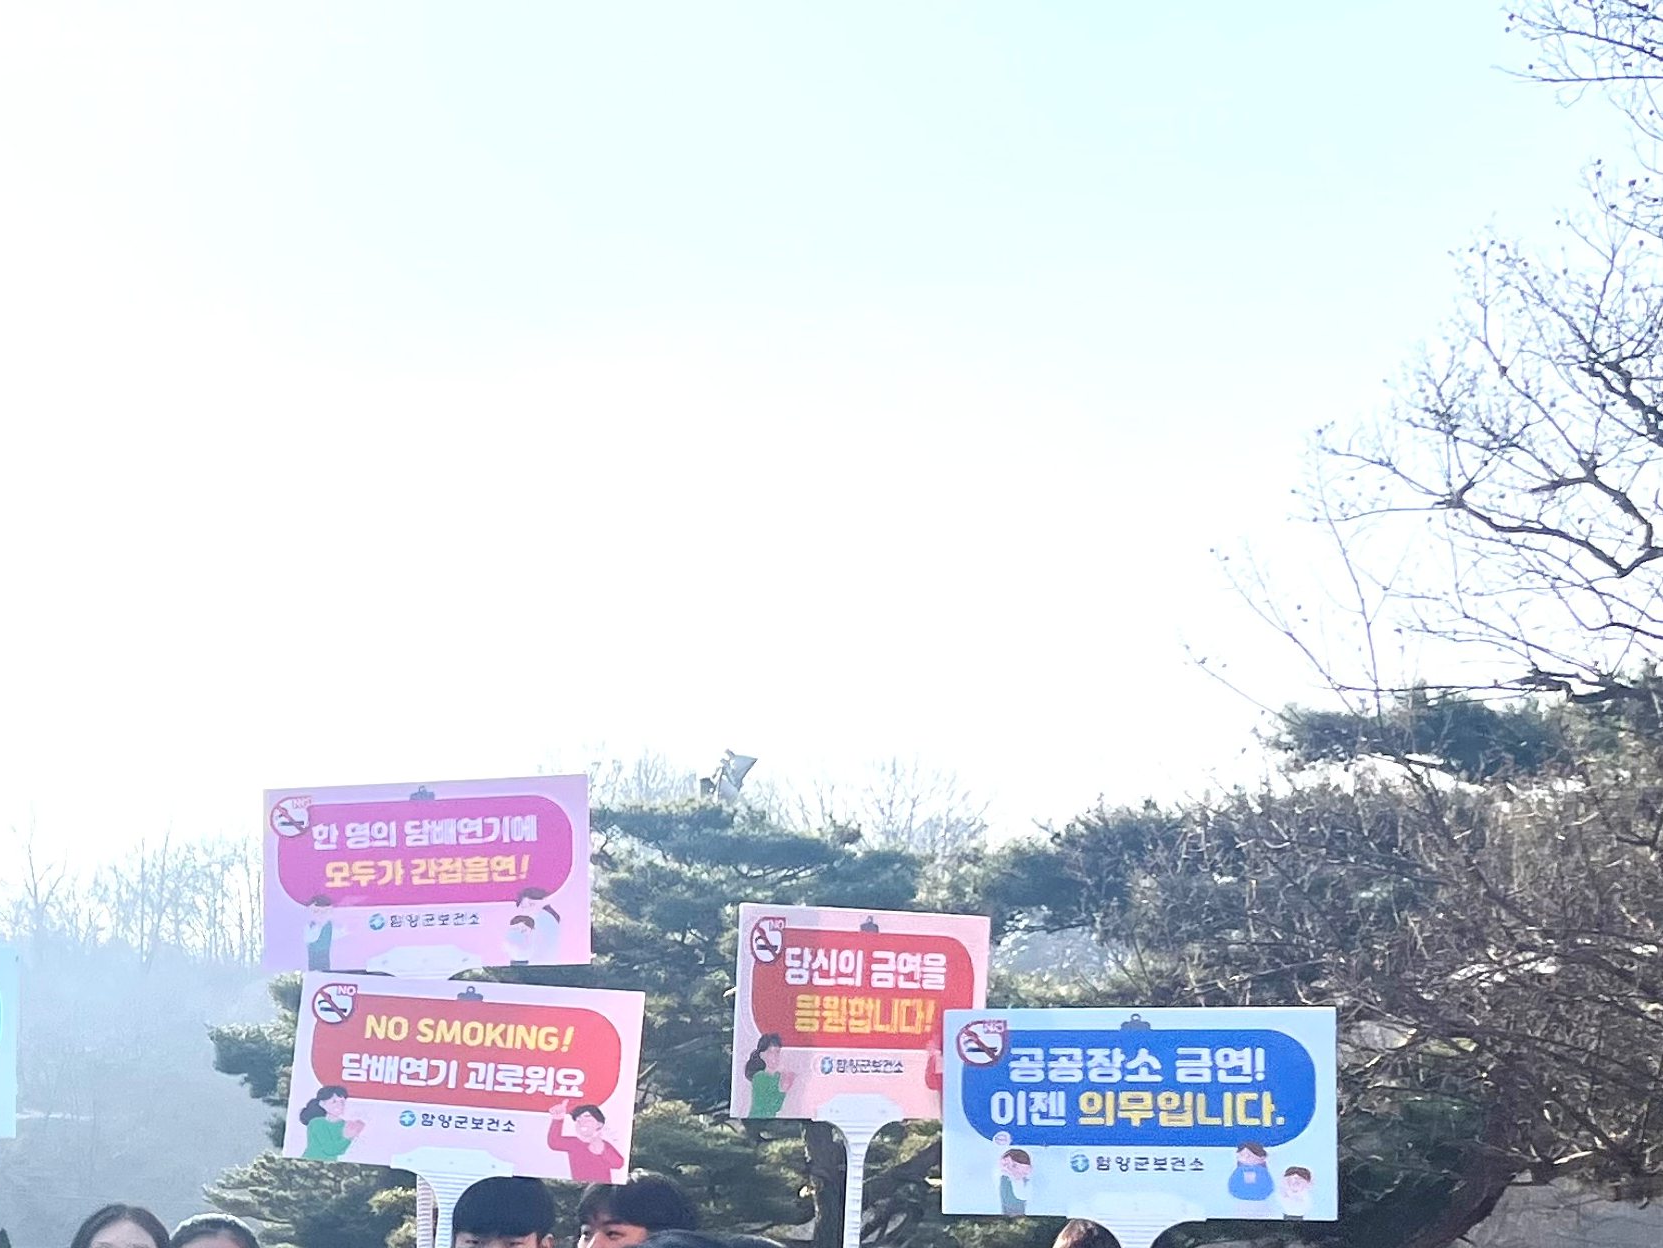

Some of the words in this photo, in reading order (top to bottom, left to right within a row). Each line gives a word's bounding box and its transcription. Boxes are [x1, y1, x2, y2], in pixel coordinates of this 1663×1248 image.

[311, 823, 338, 851] 한
[404, 815, 537, 845] 담배연기에
[325, 860, 404, 889] 모두가
[411, 855, 531, 885] 간접흡연!
[389, 913, 480, 928] 함양군보건소
[784, 947, 863, 987] 당신의
[870, 951, 947, 991] 금연을
[337, 985, 357, 996] NO
[794, 993, 935, 1035] 응원합니다!
[364, 1015, 409, 1041] NO
[416, 1018, 575, 1052] SMOKING!
[341, 1053, 458, 1089] 담배연기
[463, 1061, 585, 1098] 괴로워요
[836, 1059, 904, 1074] 함양군보건소
[1008, 1046, 1166, 1084] 공공장소
[1175, 1046, 1267, 1084] 금연!
[421, 1112, 516, 1133] 함양군보건소
[990, 1090, 1066, 1128] 이젠
[1078, 1091, 1286, 1128] 의무입니다.
[1095, 1156, 1204, 1173] 함양군보건소
